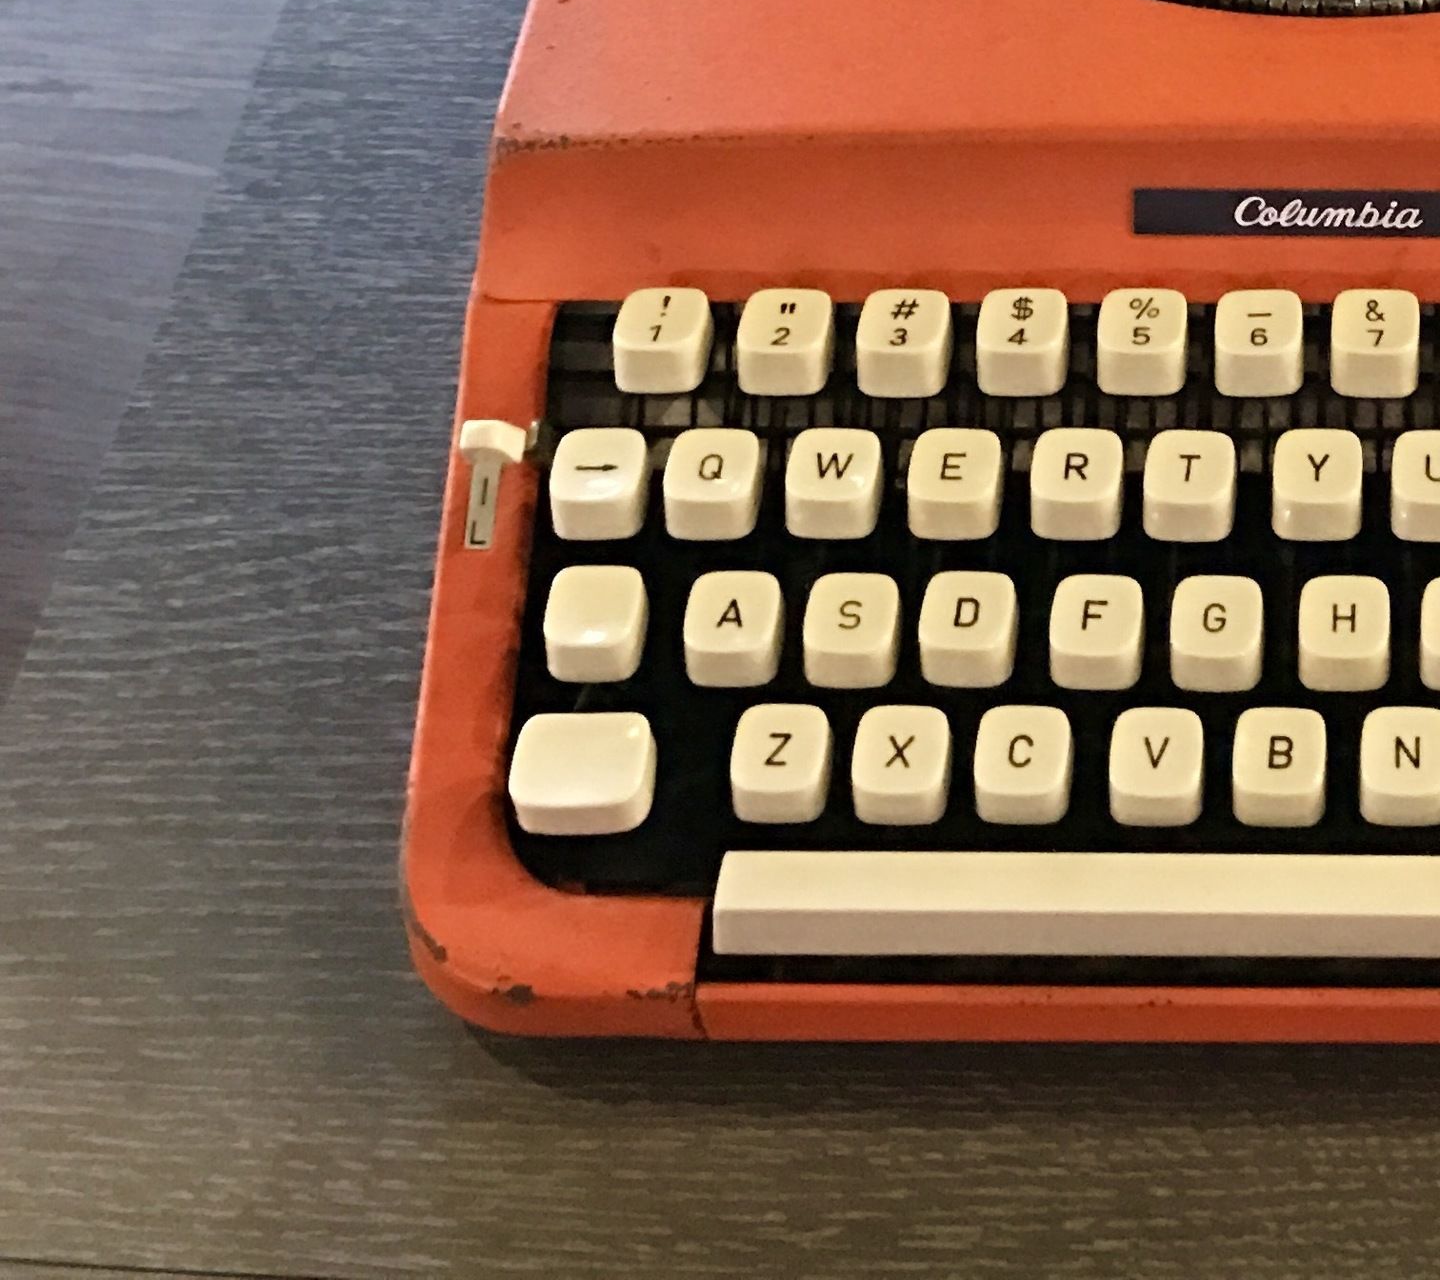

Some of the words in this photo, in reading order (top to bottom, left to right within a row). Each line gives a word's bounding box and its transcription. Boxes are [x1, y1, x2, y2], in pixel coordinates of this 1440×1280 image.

[1233, 195, 1424, 230] Columbia
[649, 324, 663, 347] 1
[769, 326, 791, 347] 2
[888, 327, 908, 347] 3
[1006, 327, 1029, 346] 4
[1131, 326, 1151, 346] 5
[1249, 327, 1269, 347] 6
[1366, 328, 1385, 348] 7
[697, 453, 724, 482] Q
[816, 451, 855, 481] W
[939, 452, 968, 481] E
[1063, 451, 1090, 481] R
[1178, 453, 1202, 483] T
[1306, 453, 1331, 483] Y
[715, 598, 744, 629] A
[837, 599, 863, 631] S
[952, 596, 981, 629] D
[1080, 599, 1109, 632] F
[1202, 602, 1227, 634] G
[1331, 602, 1357, 634] H
[763, 732, 793, 768] Z
[884, 734, 916, 769] X
[1007, 733, 1035, 769] C
[1143, 736, 1171, 770] V
[1267, 734, 1295, 770] B
[1394, 735, 1421, 770] N
